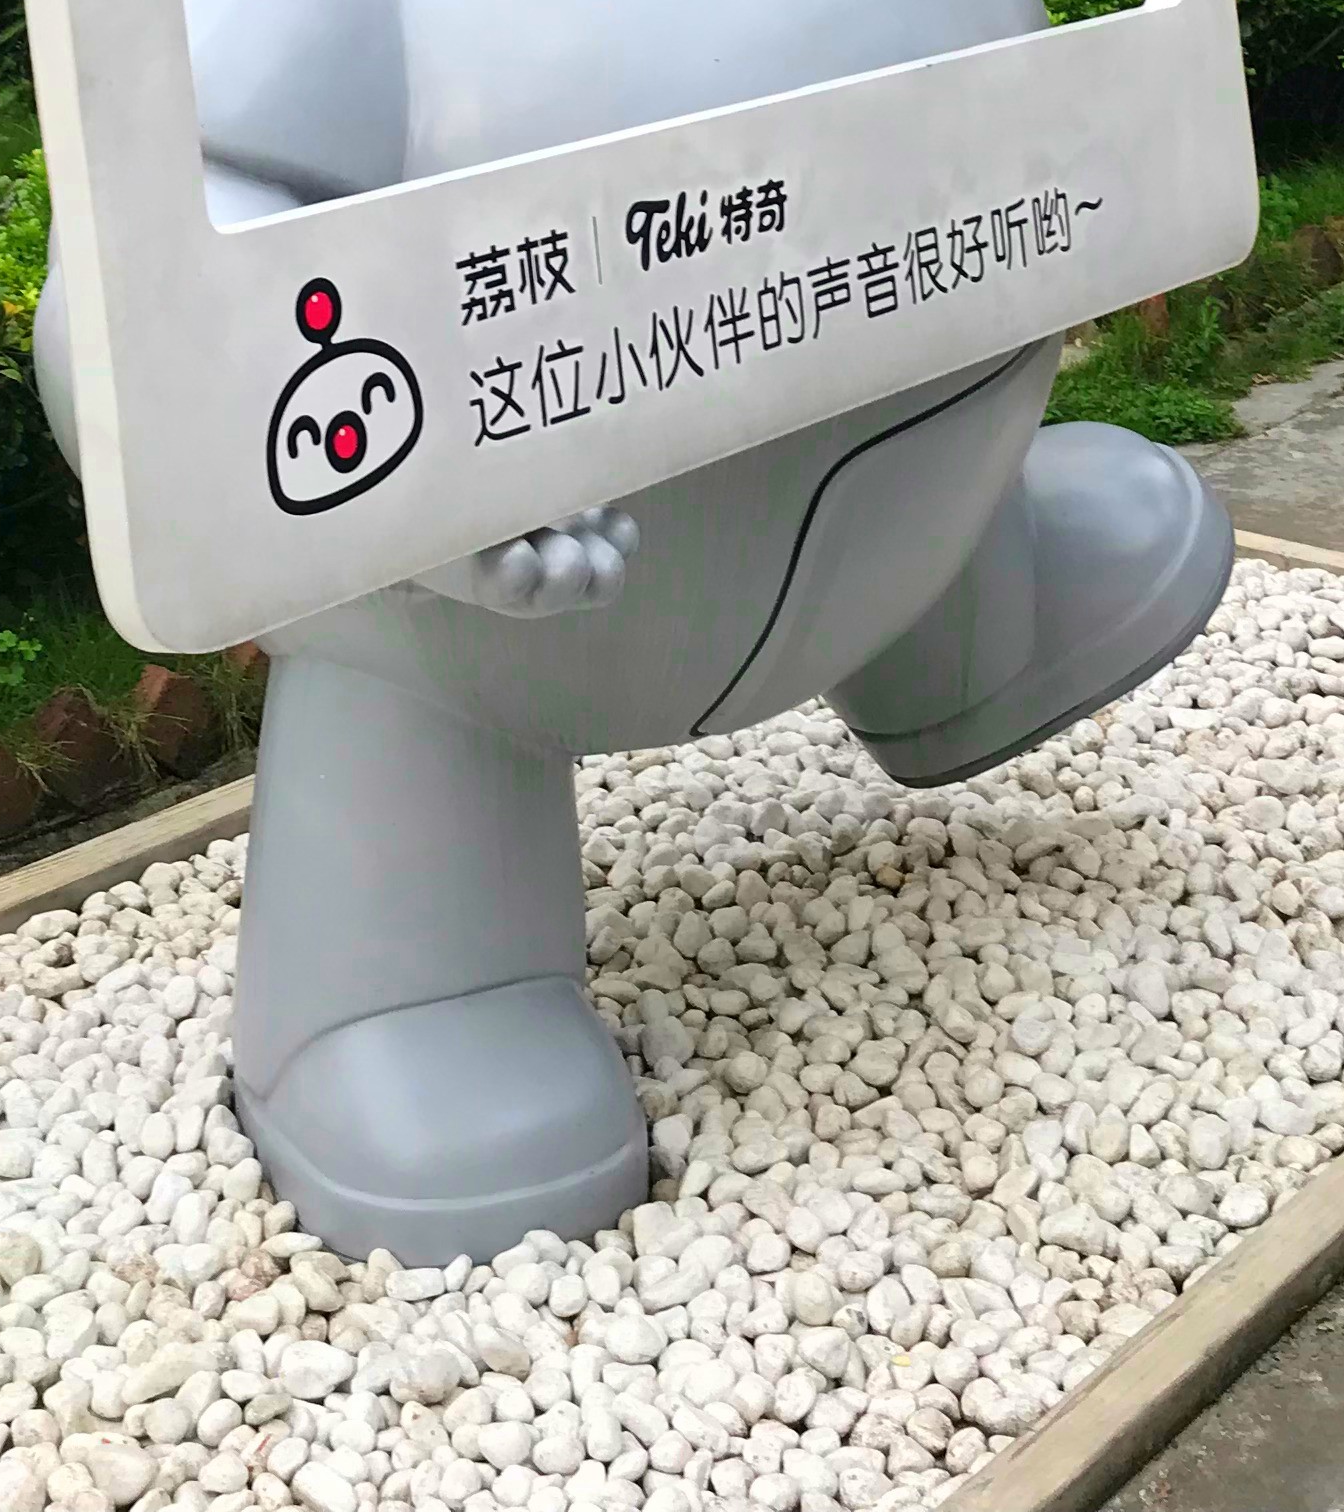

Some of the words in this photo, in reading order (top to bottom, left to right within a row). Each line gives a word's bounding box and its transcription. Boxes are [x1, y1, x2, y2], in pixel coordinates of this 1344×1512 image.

[455, 229, 577, 326] 荔枝
[625, 189, 714, 272] Teki
[719, 178, 789, 246] 特奇
